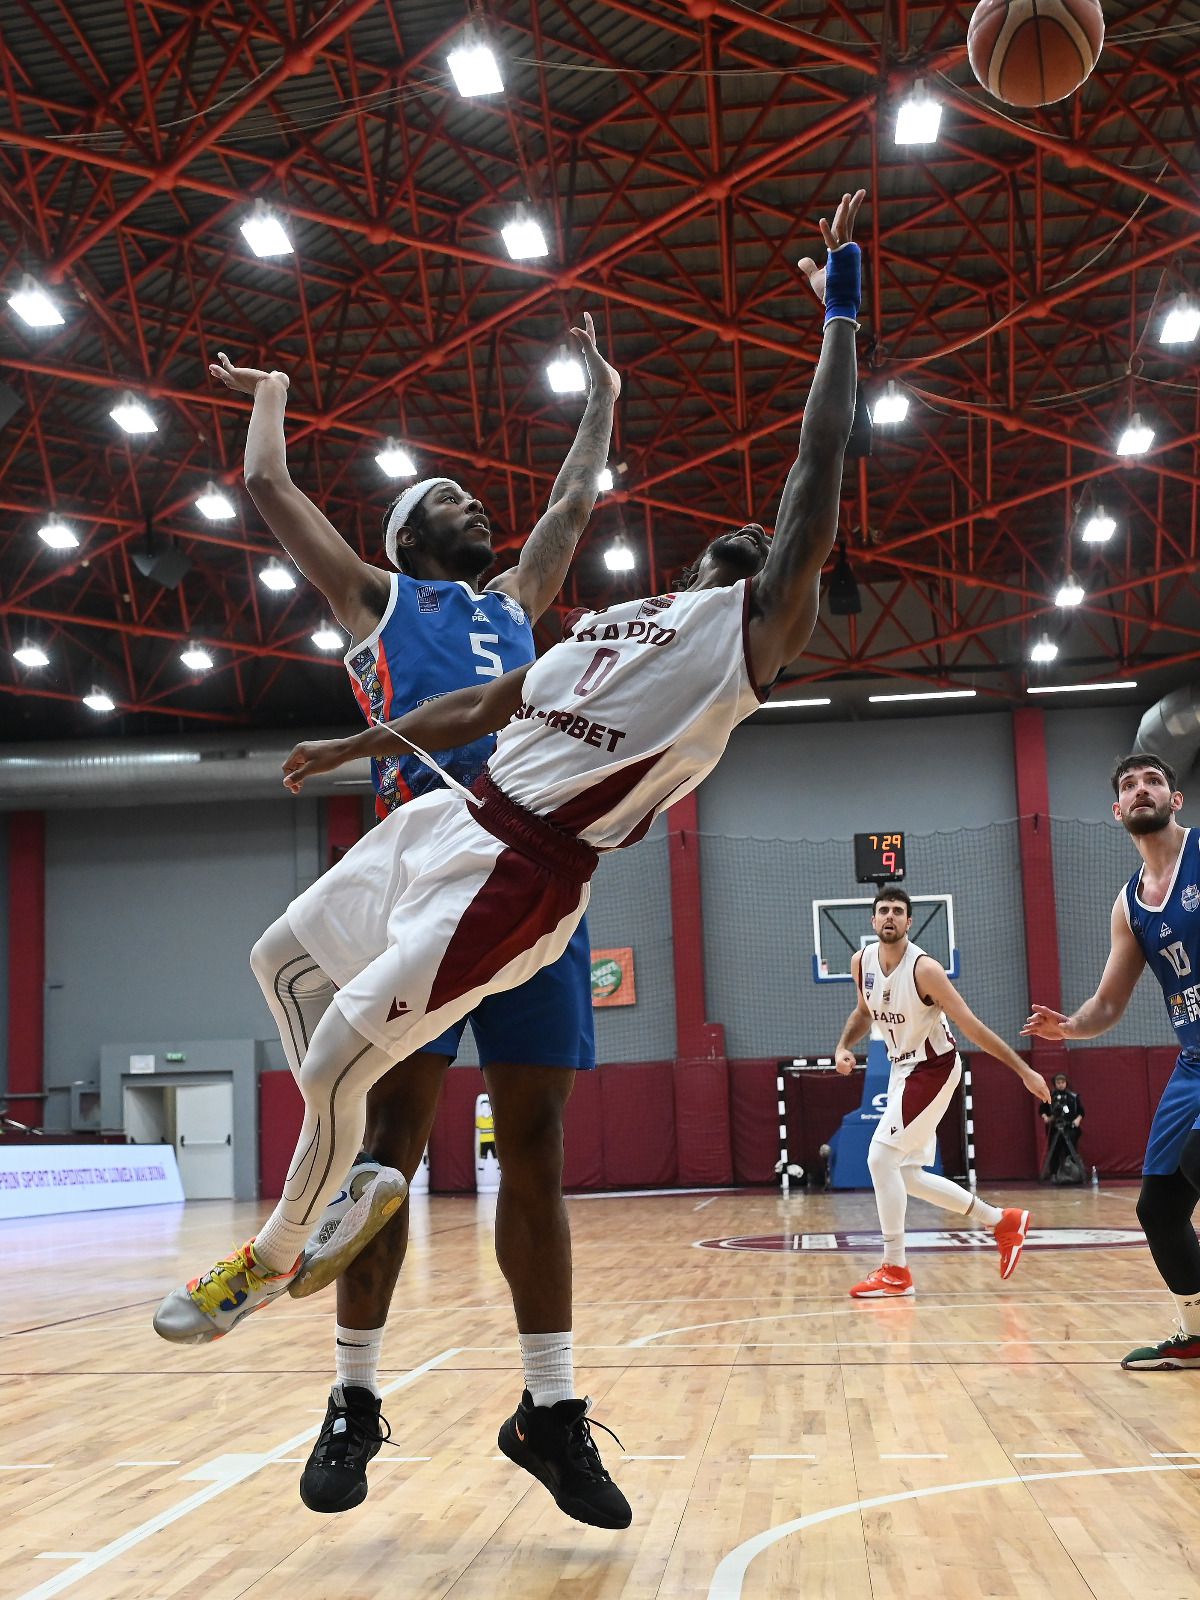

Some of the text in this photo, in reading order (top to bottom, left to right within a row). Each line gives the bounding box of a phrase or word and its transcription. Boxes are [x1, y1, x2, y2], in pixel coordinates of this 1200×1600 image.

[471, 615, 490, 623] PEA
[469, 632, 504, 678] 5
[573, 647, 620, 698] 0
[869, 834, 902, 850] 7 29
[882, 851, 896, 873] 9
[1158, 940, 1192, 979] 10
[888, 1028, 897, 1049] 1
